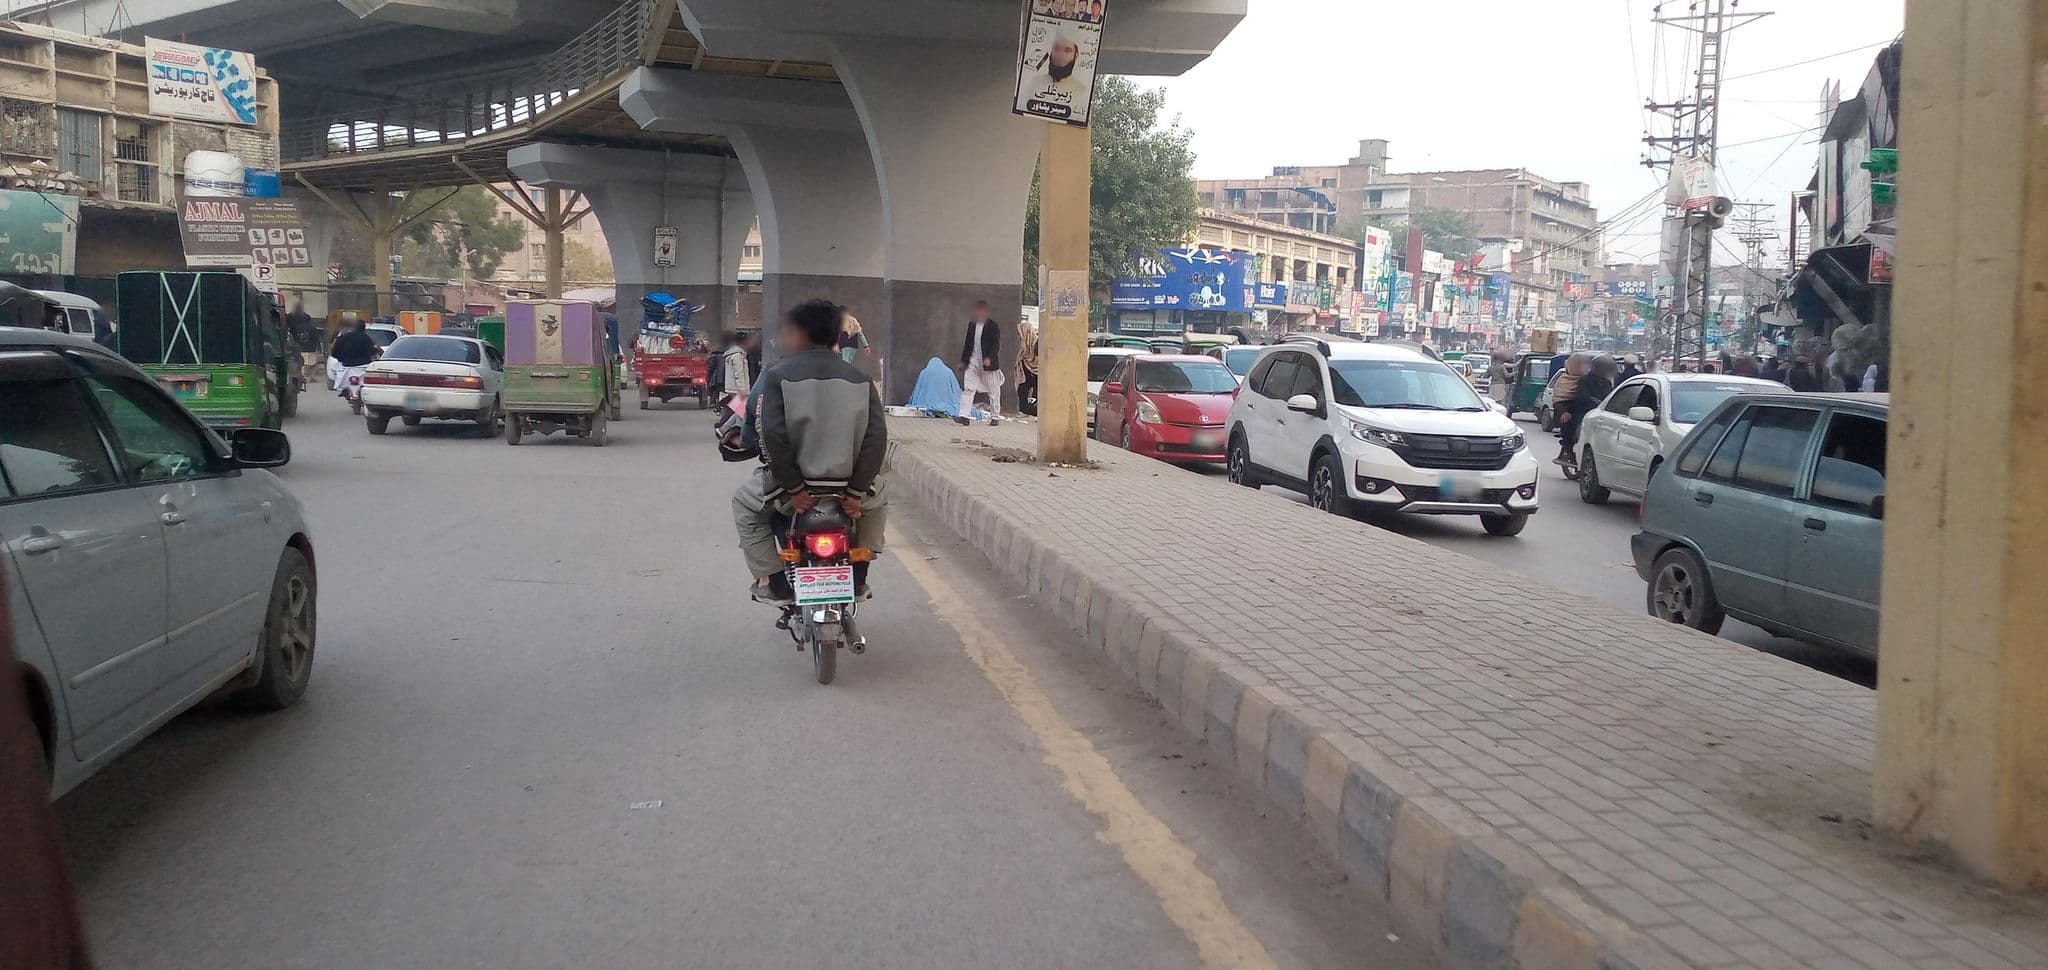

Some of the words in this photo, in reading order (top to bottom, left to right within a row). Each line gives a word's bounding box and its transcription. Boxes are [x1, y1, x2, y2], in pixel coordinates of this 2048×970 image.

[201, 89, 215, 103] تاج
[184, 201, 245, 222] AJMAL
[259, 266, 270, 278] P
